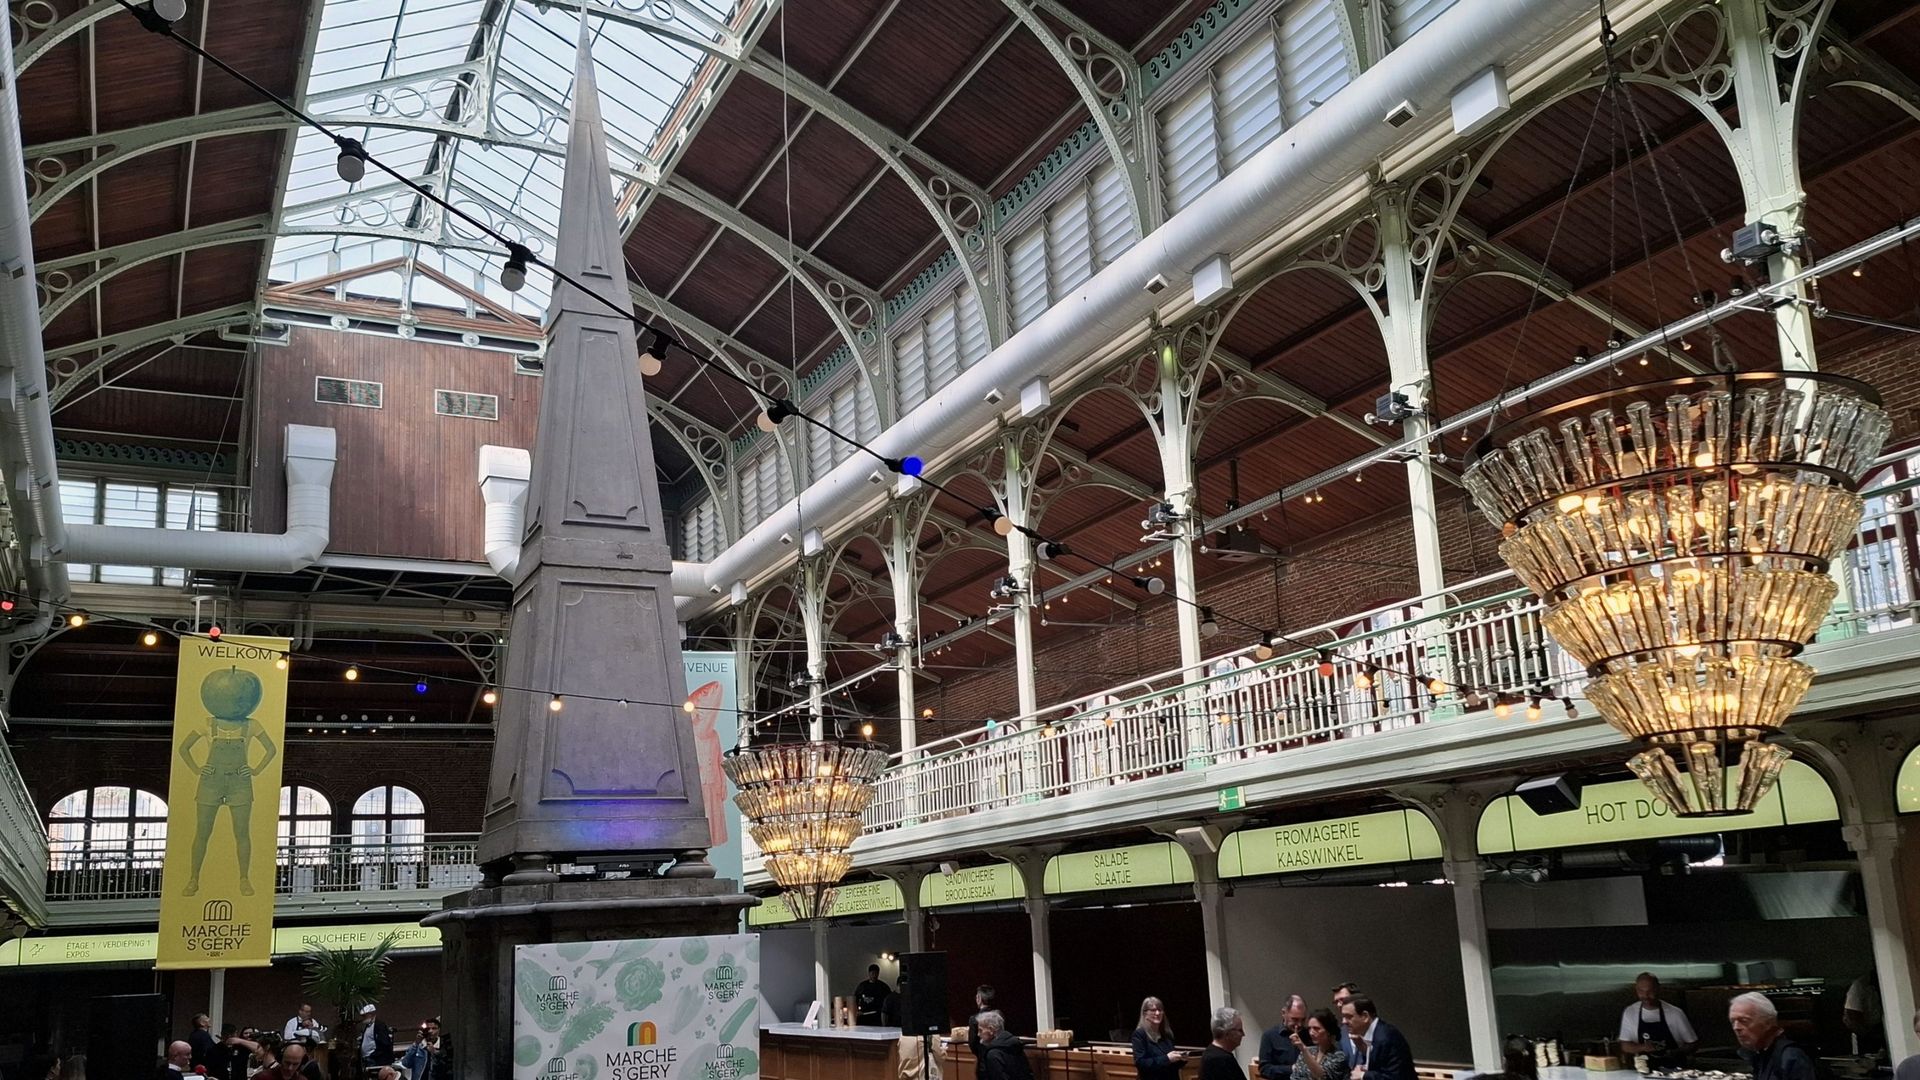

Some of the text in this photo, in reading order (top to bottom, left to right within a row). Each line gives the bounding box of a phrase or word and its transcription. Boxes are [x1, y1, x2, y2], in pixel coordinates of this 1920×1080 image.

[198, 645, 272, 660] WELKOM
[683, 662, 728, 673] VENUE
[1585, 798, 1668, 824] HOT DO
[1275, 821, 1361, 847] FROMAGERIE
[1094, 851, 1129, 868] SALADE
[1277, 844, 1364, 868] KAASWINKEL
[945, 868, 995, 886] SANDWICHERIE
[1094, 869, 1132, 886] SLAATJE
[945, 884, 996, 902] BROODJESZAAK
[102, 939, 145, 949] VERDIEPING
[302, 932, 367, 944] BOUCHERIE
[66, 950, 90, 959] EXPOS
